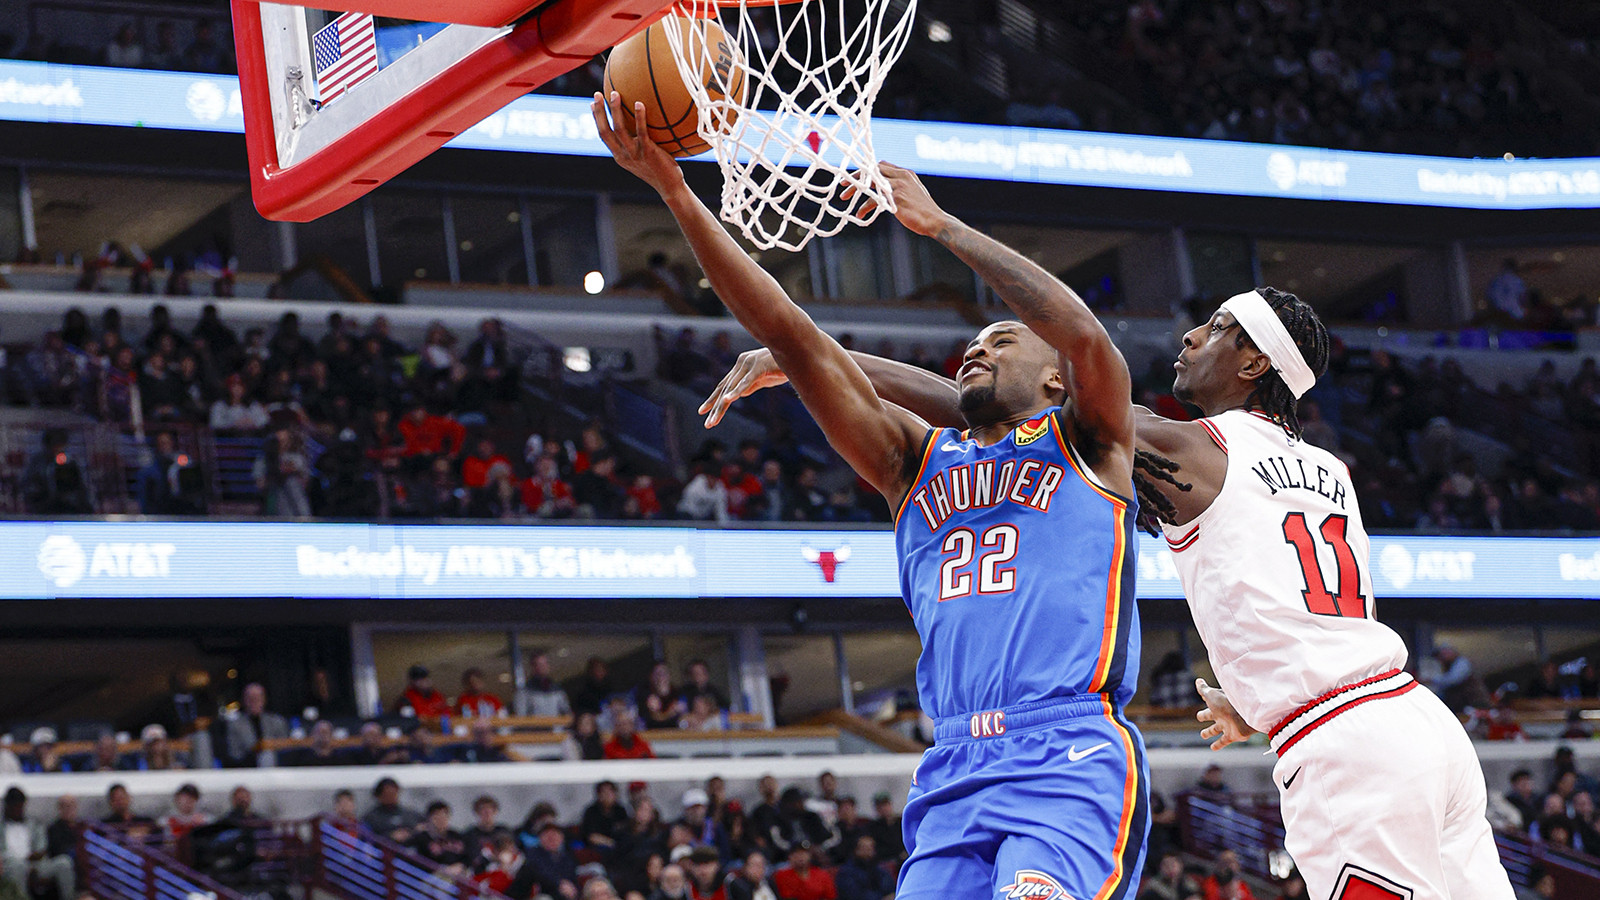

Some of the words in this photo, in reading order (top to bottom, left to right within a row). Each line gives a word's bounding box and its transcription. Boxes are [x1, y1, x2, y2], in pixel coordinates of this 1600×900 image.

[912, 458, 1066, 534] THUNDER
[1251, 456, 1346, 510] MILLER
[90, 542, 176, 577] AT&T
[296, 545, 401, 577] Backed
[403, 545, 443, 585] by
[445, 545, 538, 578] AT&T's
[539, 546, 577, 578] 5G
[578, 545, 696, 578] Network
[938, 522, 1020, 602] 22
[1281, 511, 1368, 619] 11
[1416, 551, 1475, 581] AT&T
[970, 711, 1006, 739] OKC
[1008, 881, 1054, 899] OKC
